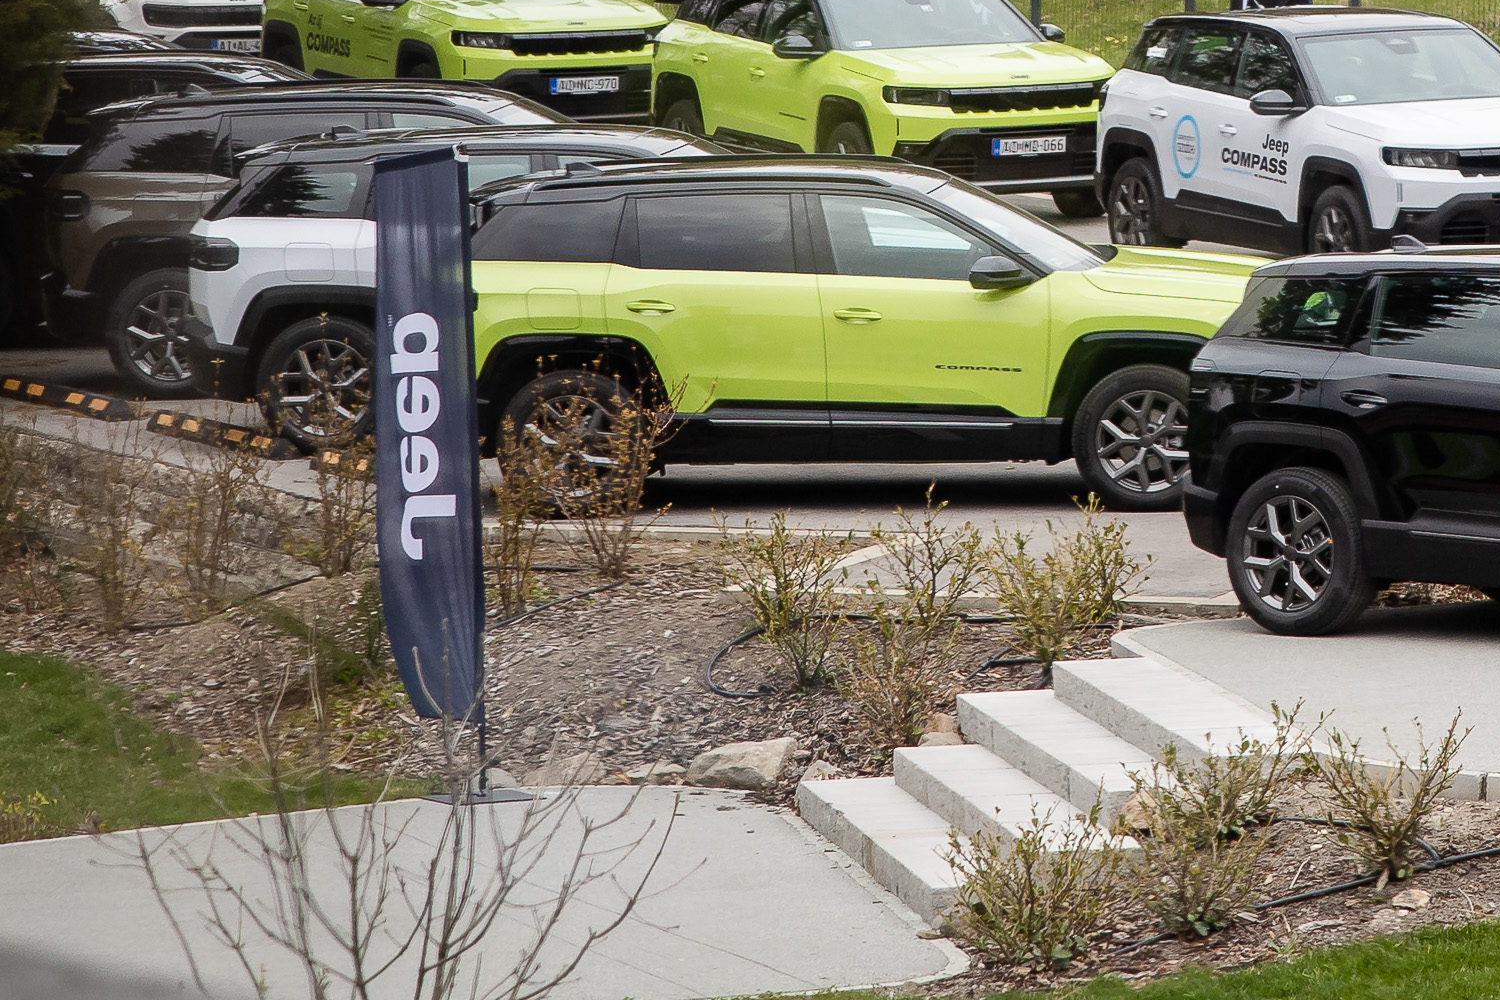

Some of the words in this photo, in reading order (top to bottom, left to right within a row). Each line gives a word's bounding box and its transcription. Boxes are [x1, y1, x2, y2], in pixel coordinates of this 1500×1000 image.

[306, 31, 351, 58] COMPASS
[1262, 133, 1289, 157] Jeep
[1221, 147, 1288, 176] COMPASS
